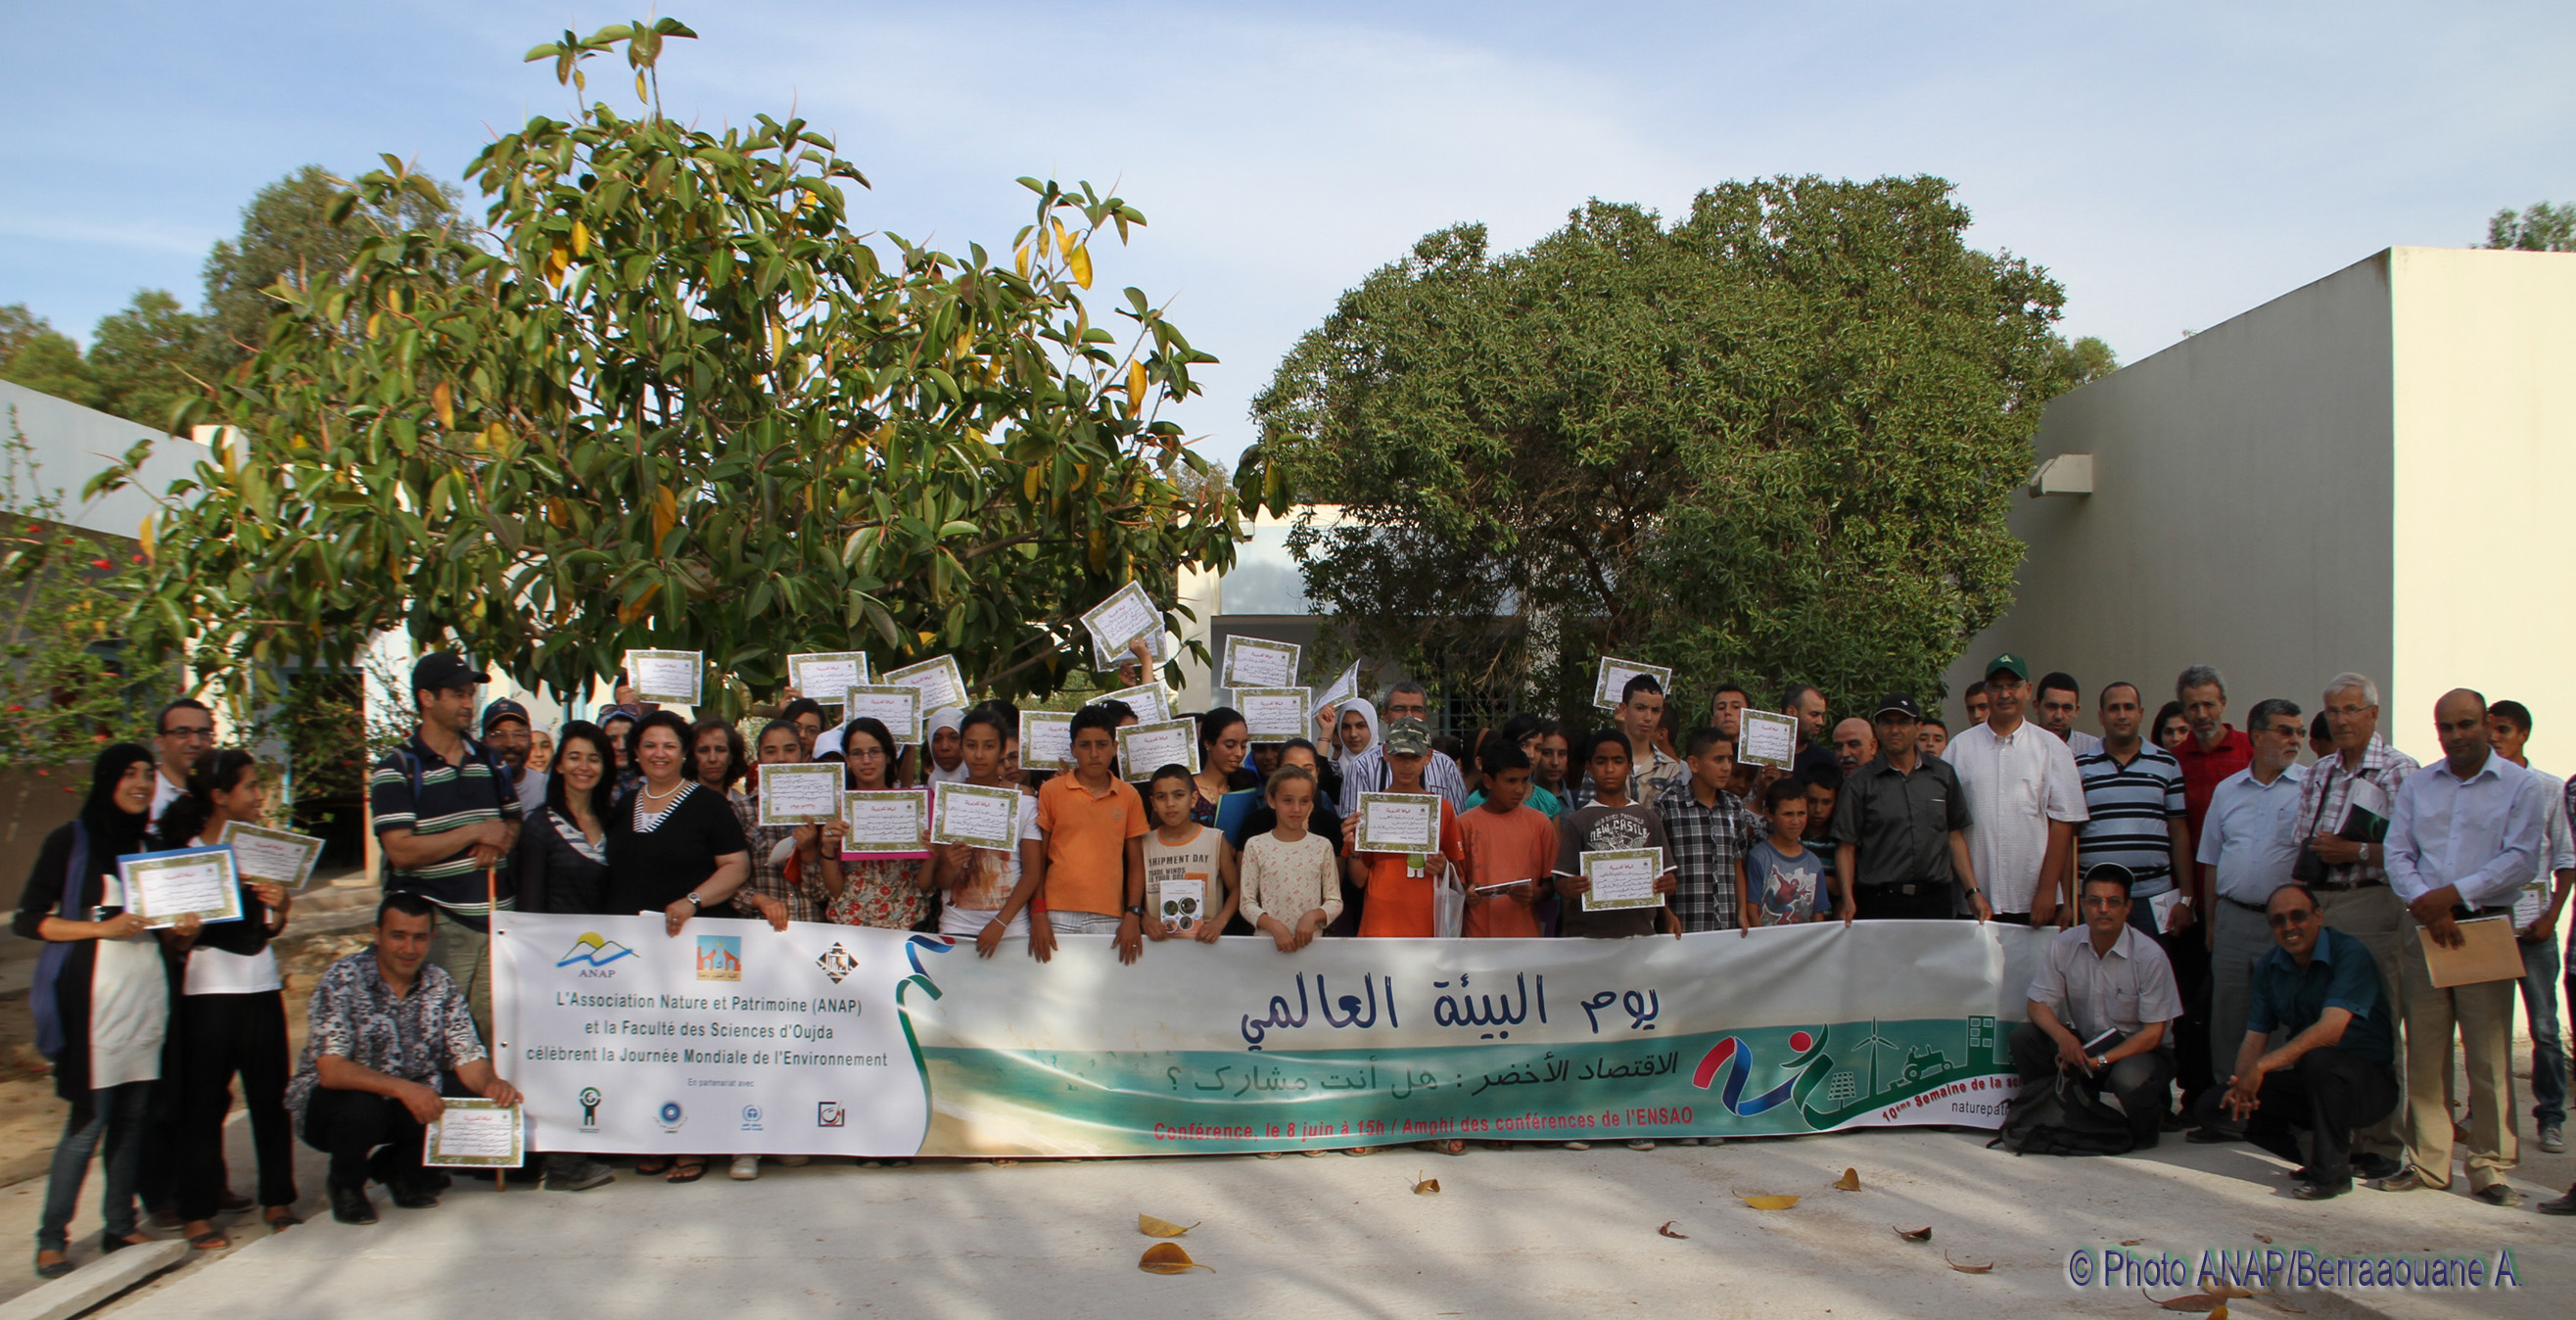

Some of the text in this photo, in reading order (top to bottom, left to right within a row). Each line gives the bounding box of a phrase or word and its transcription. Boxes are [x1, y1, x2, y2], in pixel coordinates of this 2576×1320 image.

[1590, 823, 1611, 842] NEW
[1613, 819, 1648, 838] CASTLE
[1147, 854, 1209, 867] SHIPMENT DAY
[579, 968, 616, 978] ANAP
[556, 991, 862, 1016] L'Association Nature et Patrimoine (ANAP)
[1241, 970, 1660, 1052] يوم البيئة العالمي
[585, 1019, 834, 1042] et la Faculté des Sciences d'Oujda
[526, 1045, 888, 1066] célèbrent la Journée Mondiale de l'Environnement
[1577, 1051, 1679, 1080] الاقتصاد
[687, 1078, 697, 1087] En
[698, 1078, 736, 1089] partenariat
[1166, 1065, 1183, 1091] ؟
[1194, 1064, 1309, 1098] مشارك
[1320, 1055, 1380, 1091] أنت
[1390, 1064, 1438, 1100] هل
[1471, 1051, 1570, 1097] الأخضر
[1914, 1084, 1967, 1108] Semaine
[1971, 1078, 1986, 1091] de
[1990, 1076, 2002, 1089] la
[1951, 1101, 2010, 1117] naturepatr
[1152, 1107, 1694, 1142] Conférence, le 8 juin à 15h / Amphi des conférences de l'ENSAO
